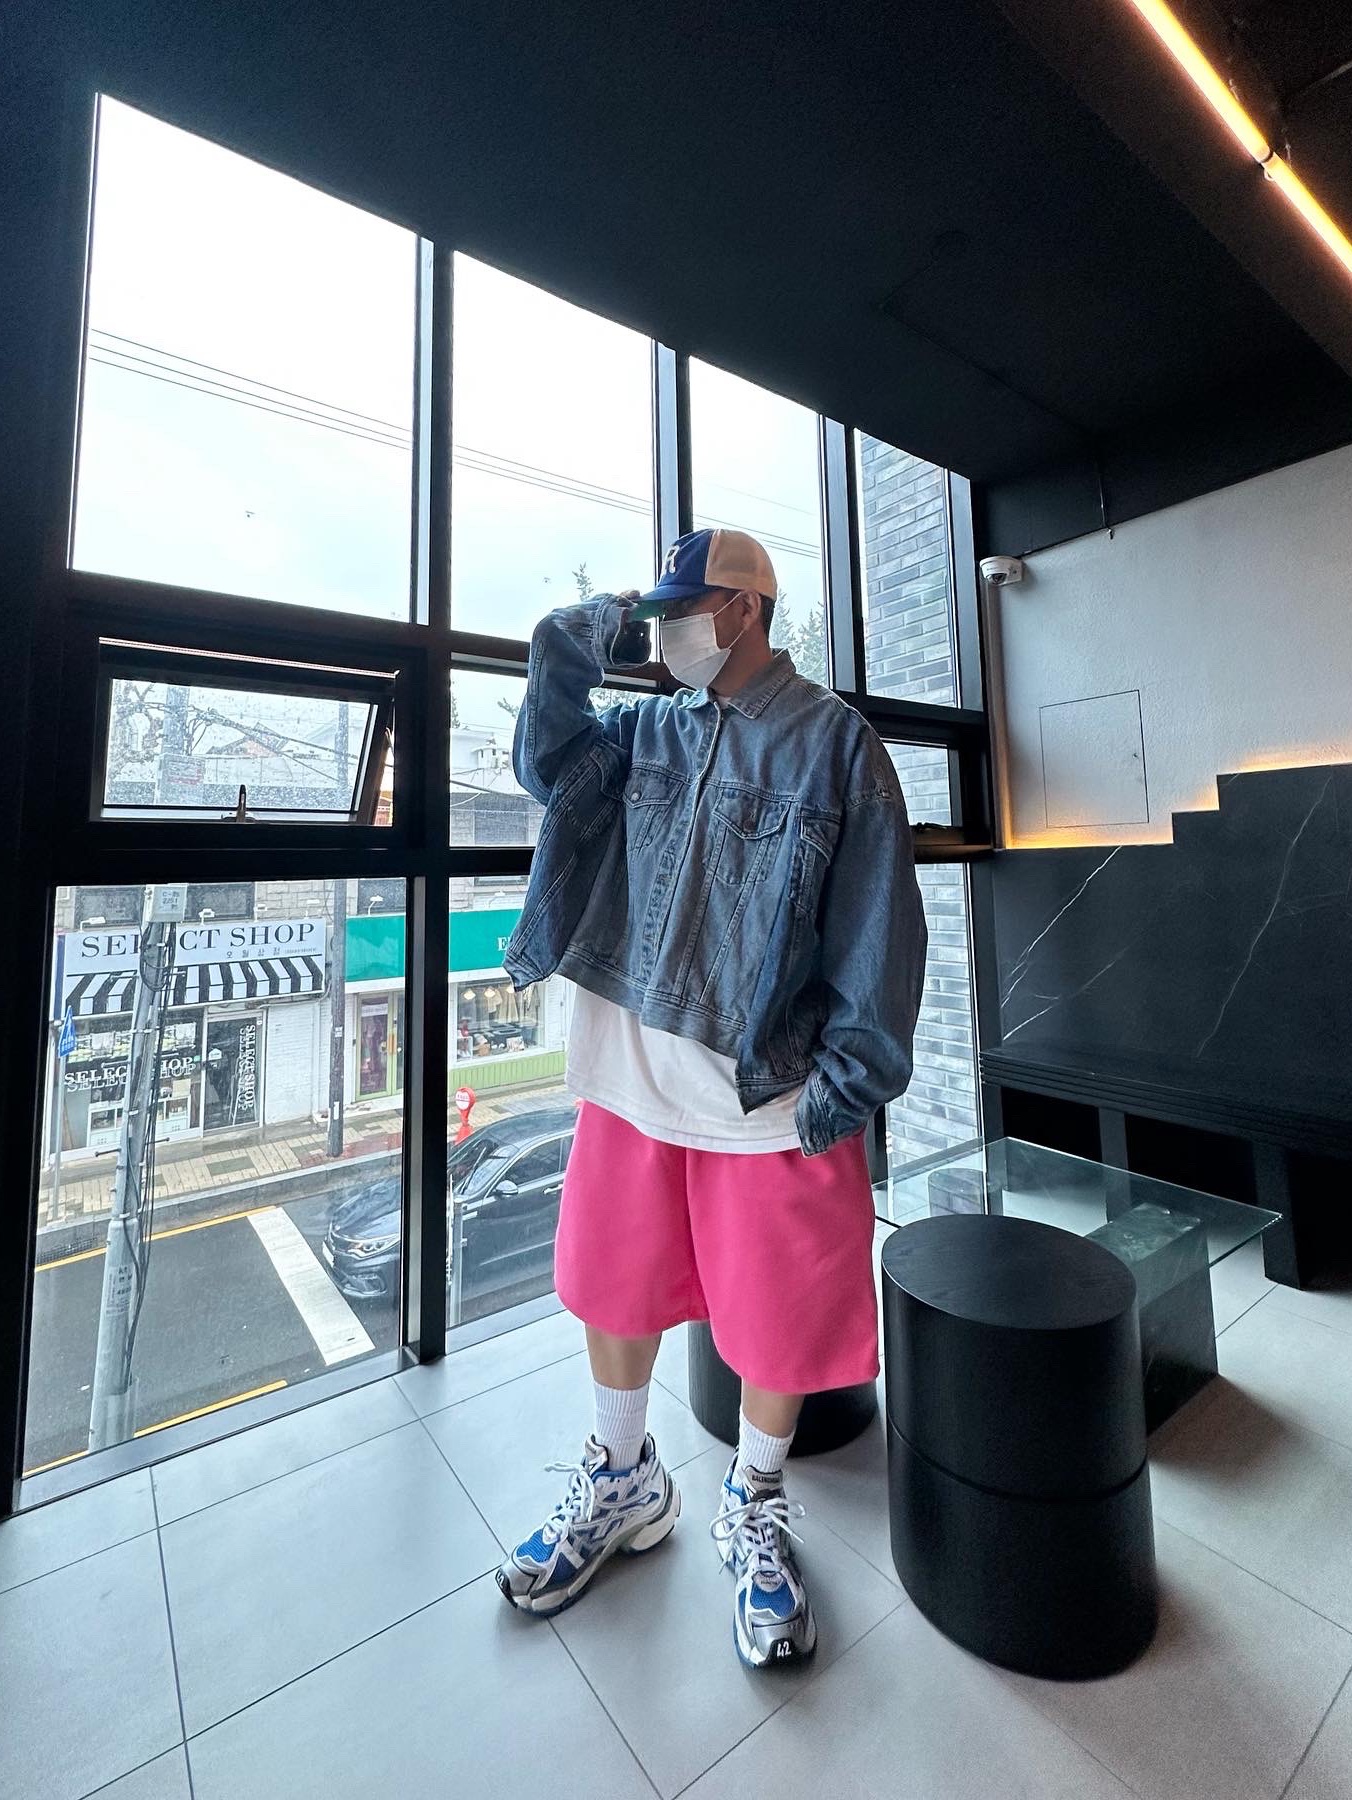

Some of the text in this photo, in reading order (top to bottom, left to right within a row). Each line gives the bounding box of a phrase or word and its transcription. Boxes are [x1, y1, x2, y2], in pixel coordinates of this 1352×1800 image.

[81, 923, 315, 957] SECT SHOP
[64, 1065, 128, 1085] SELEC
[776, 1640, 792, 1657] 42
